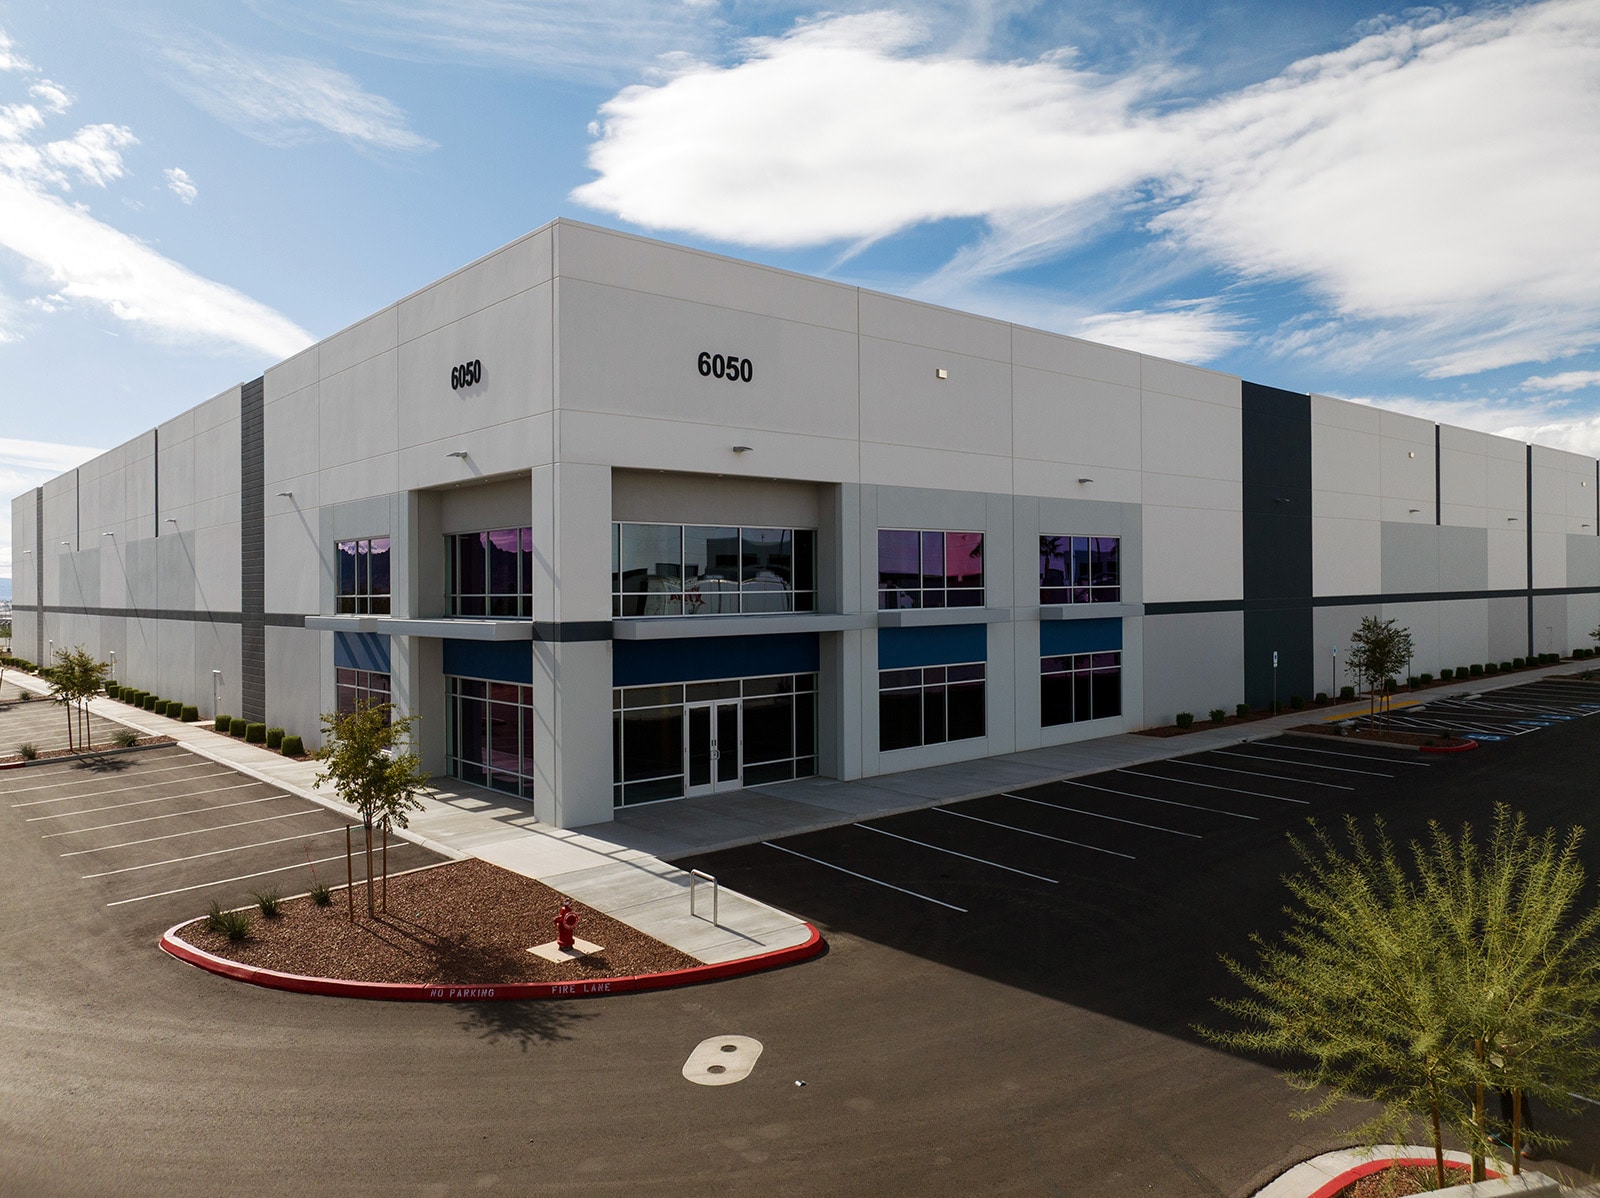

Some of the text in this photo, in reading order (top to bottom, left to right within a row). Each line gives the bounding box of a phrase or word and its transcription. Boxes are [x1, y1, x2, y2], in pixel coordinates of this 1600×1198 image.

[451, 359, 481, 390] 6050
[698, 352, 753, 383] 6050
[430, 988, 495, 998] NO PARKING
[551, 983, 611, 994] FIRE LANE
